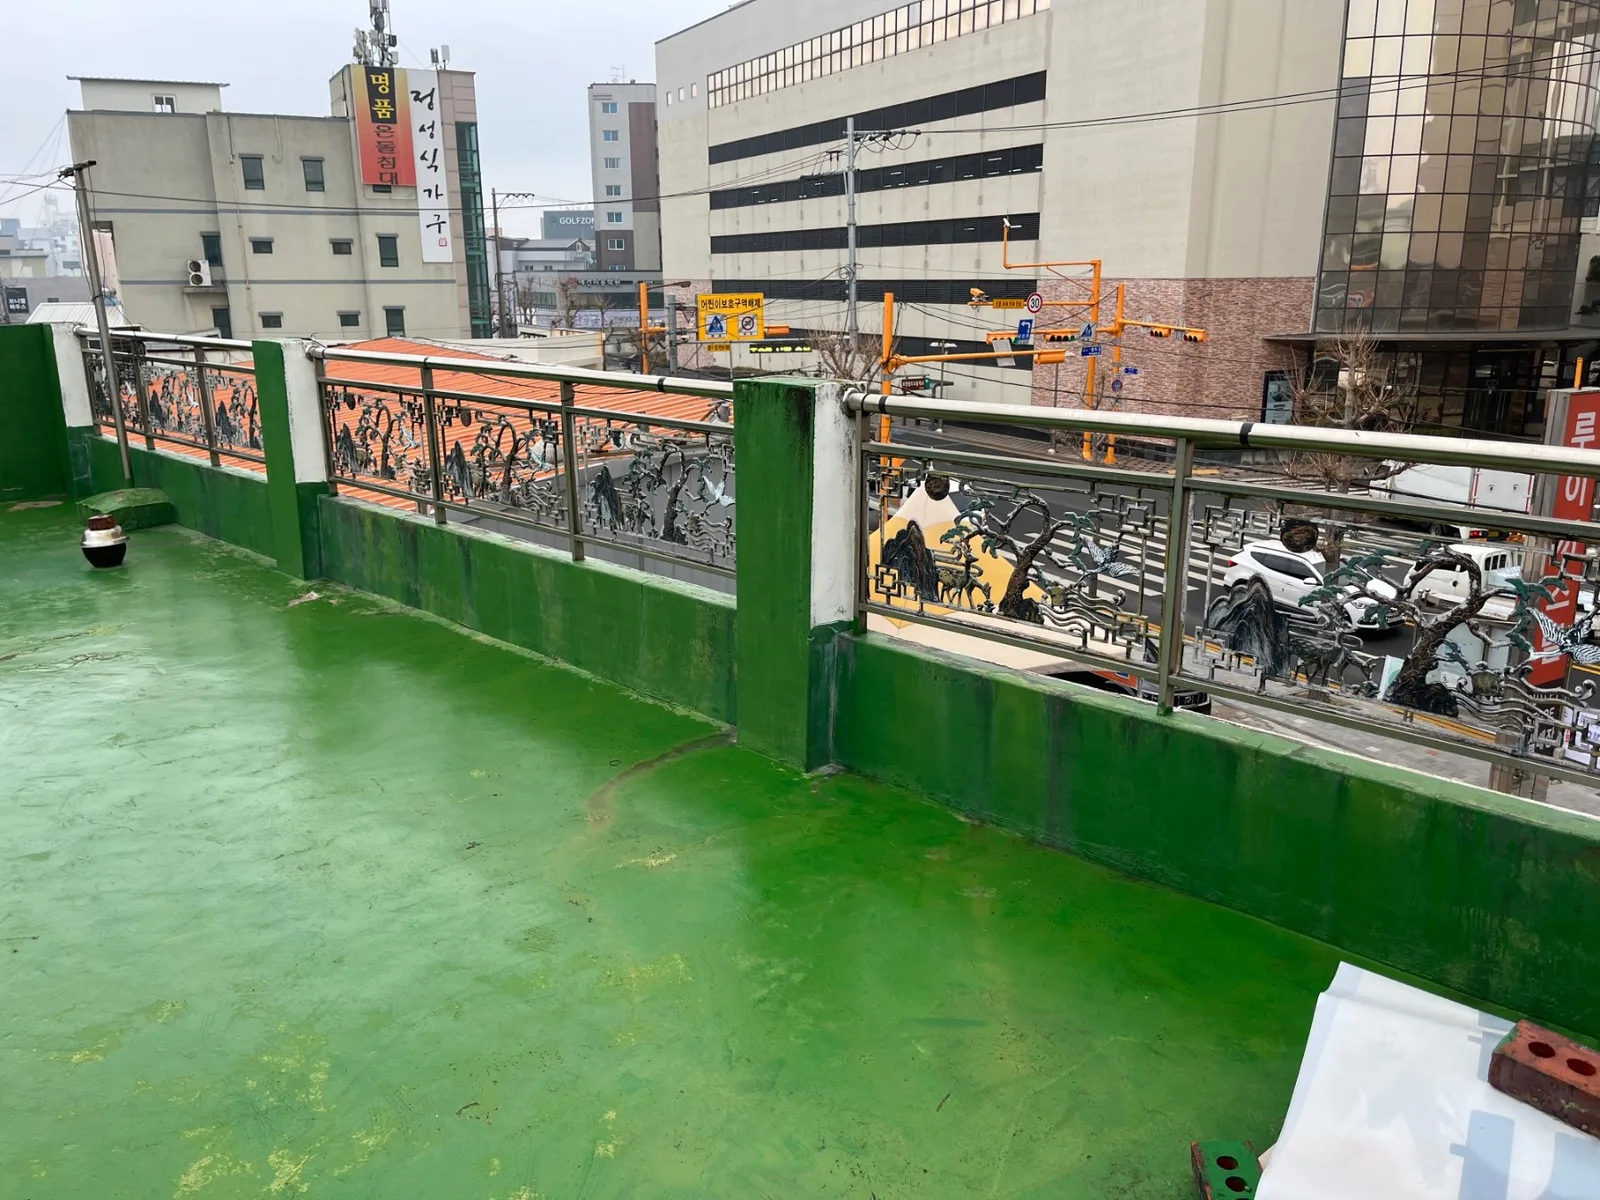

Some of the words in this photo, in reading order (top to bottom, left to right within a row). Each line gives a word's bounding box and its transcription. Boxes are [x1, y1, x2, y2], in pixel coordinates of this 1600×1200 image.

[370, 72, 394, 119] 명품
[373, 124, 399, 185] 온돌침대
[410, 88, 447, 234] 정성식가구
[700, 298, 761, 310] 어린이보호구역해제
[1030, 298, 1040, 309] 30
